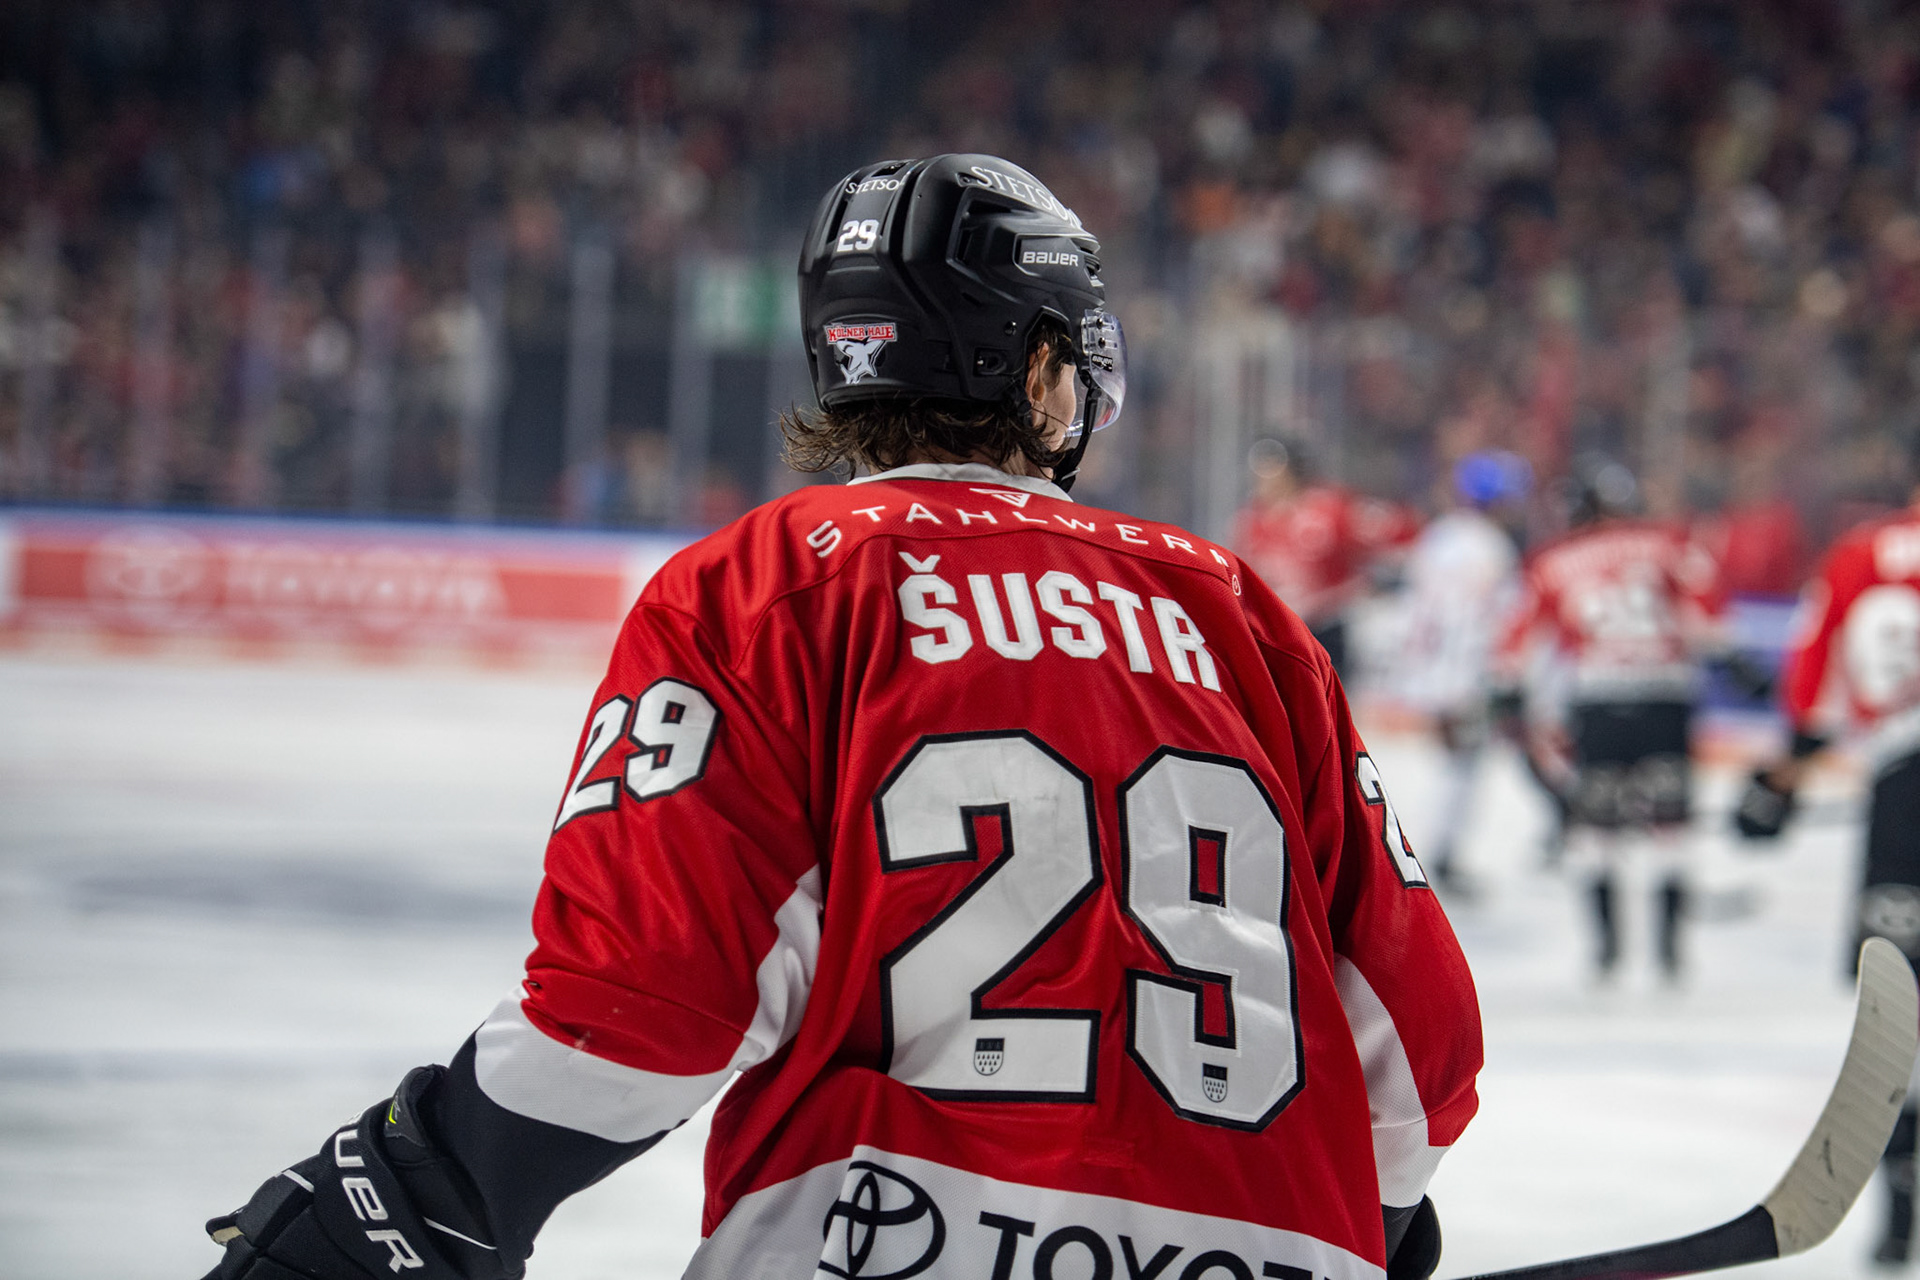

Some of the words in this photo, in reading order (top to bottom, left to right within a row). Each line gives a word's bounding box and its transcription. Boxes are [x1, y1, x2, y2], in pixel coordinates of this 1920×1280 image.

[845, 179, 902, 195] STETSO
[836, 219, 880, 252] 29
[1022, 251, 1079, 267] BAUER
[828, 325, 866, 341] KÖLNER
[867, 325, 894, 339] HAIE
[897, 551, 1222, 693] ŠUSTR
[551, 675, 724, 839] 29
[872, 728, 1307, 1134] 29
